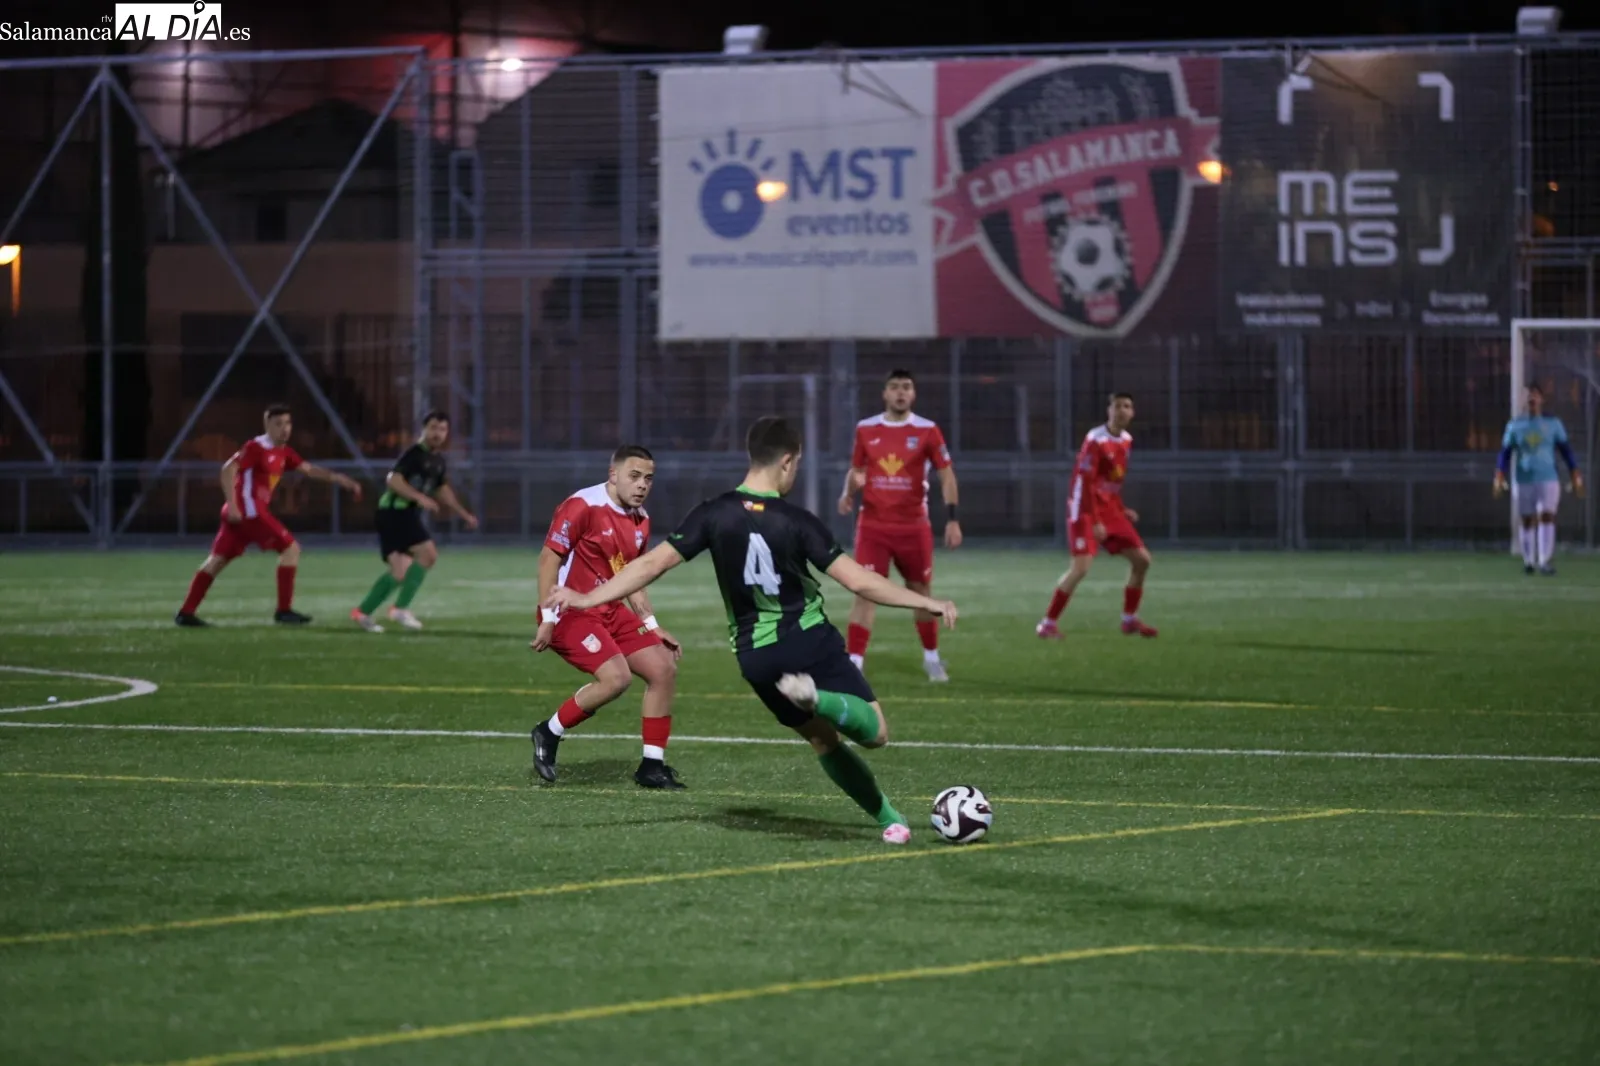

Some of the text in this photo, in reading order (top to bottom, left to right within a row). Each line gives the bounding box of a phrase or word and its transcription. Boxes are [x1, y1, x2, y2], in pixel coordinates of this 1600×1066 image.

[788, 148, 915, 201] MST
[786, 210, 910, 236] eventos
[743, 532, 783, 596] 4
